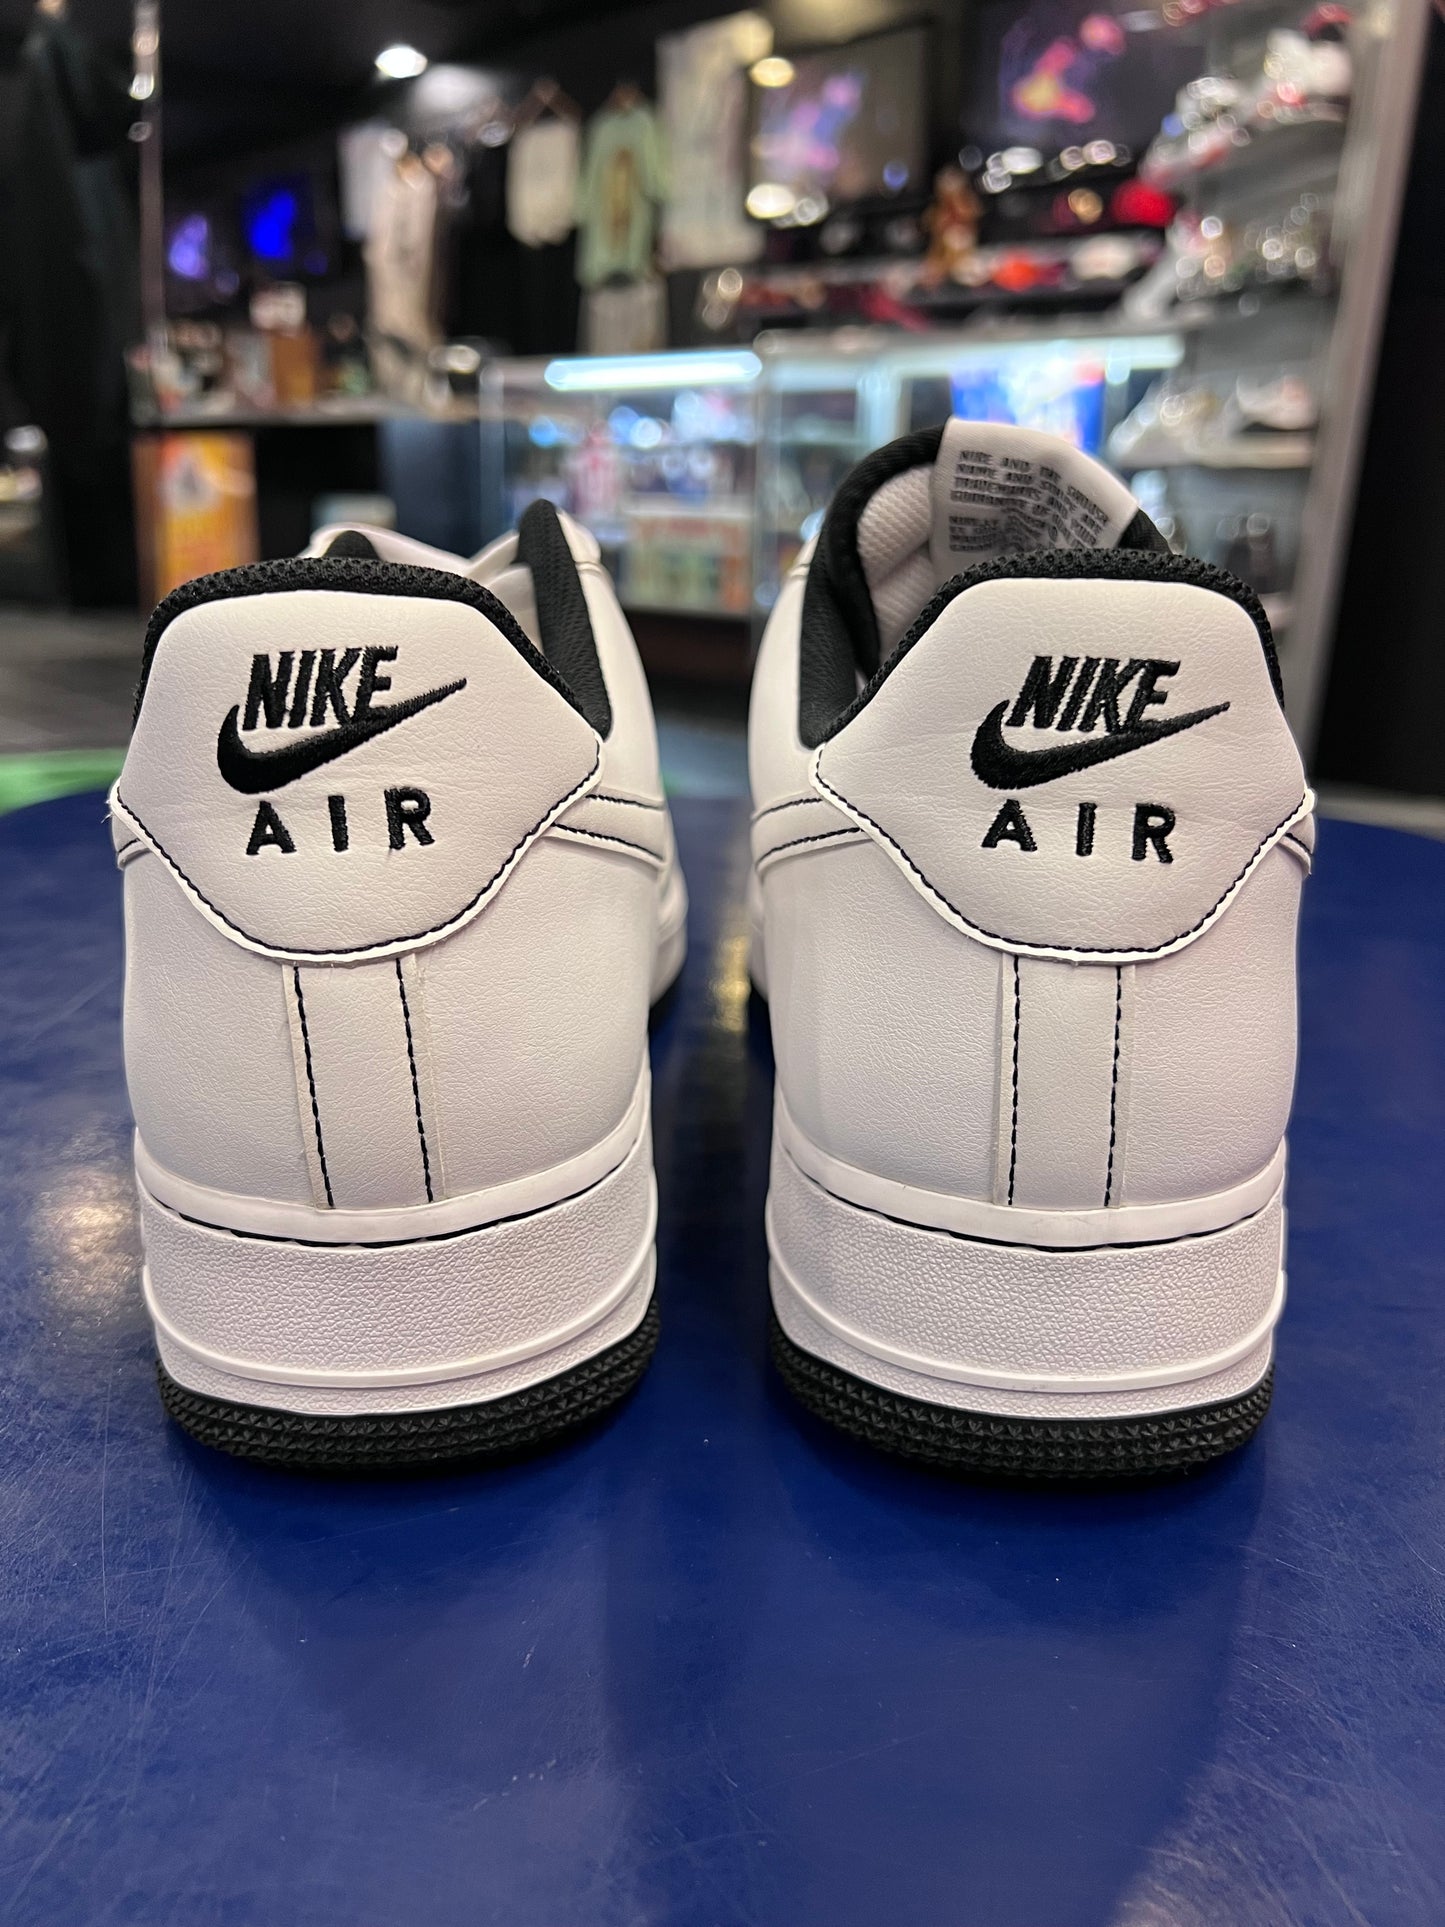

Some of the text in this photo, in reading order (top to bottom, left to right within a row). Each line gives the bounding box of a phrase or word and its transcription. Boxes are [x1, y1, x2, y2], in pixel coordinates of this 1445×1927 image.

[1001, 457, 1031, 473] AND
[1005, 472, 1034, 485] AND
[242, 645, 398, 731] NIKE
[1005, 655, 1181, 733] NIKE
[245, 785, 435, 855] AIR
[981, 798, 1176, 864] AIR
